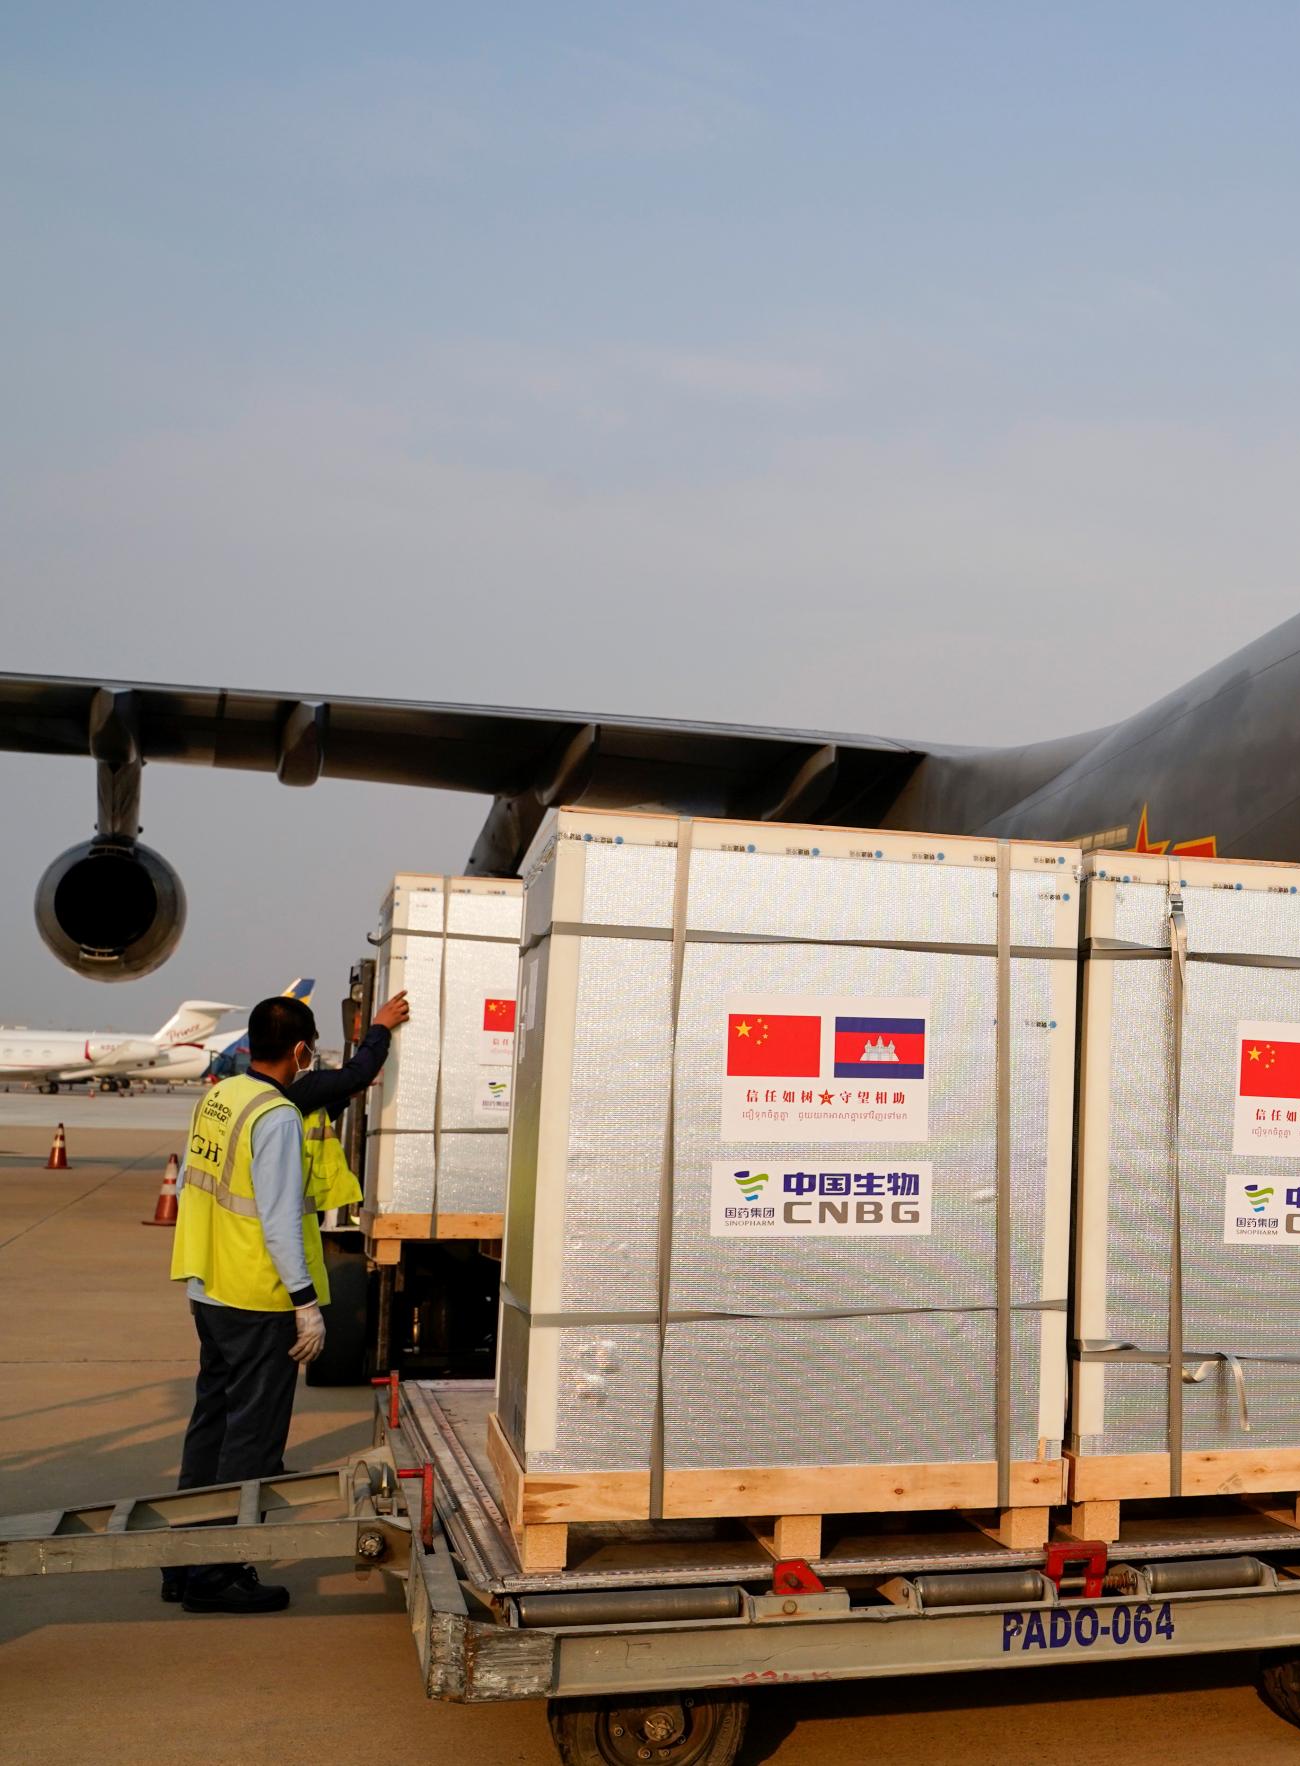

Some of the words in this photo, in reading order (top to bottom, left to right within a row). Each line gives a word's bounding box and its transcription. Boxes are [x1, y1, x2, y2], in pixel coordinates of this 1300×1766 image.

[745, 1089, 814, 1104] 信任如树
[838, 1090, 906, 1105] 守望相助
[783, 1172, 920, 1196] 中国生物
[725, 1207, 775, 1219] 国药集团
[783, 1201, 920, 1224] CNBG
[1236, 1217, 1279, 1229] 国药集团
[1236, 1228, 1279, 1237] SINOPHARM
[1002, 1601, 1175, 1652] PADO-064
